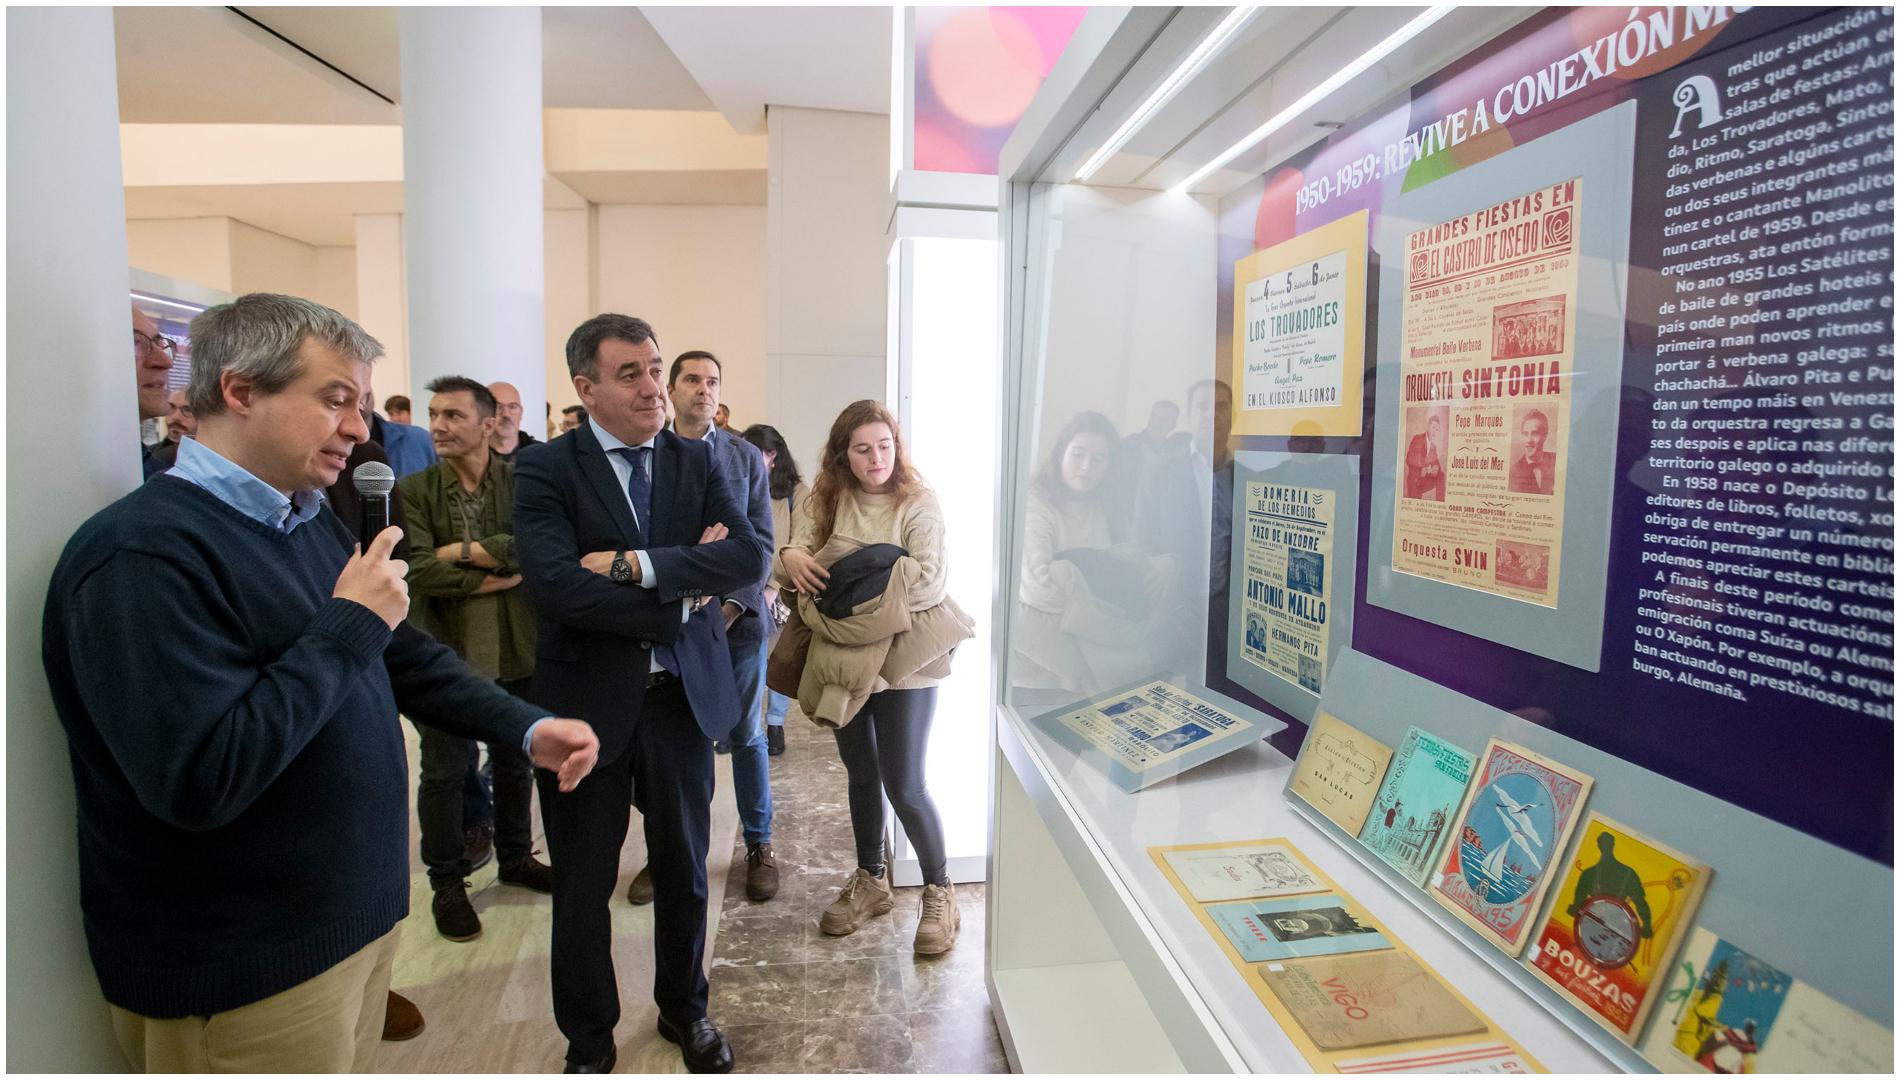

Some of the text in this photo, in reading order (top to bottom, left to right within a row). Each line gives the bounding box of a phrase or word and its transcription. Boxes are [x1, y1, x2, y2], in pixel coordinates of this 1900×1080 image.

[1668, 10, 1876, 139] A mellor situación
[1727, 36, 1869, 97] tras que actúan
[1725, 65, 1858, 119] salas festas:
[1295, 152, 1382, 216] 1950-1959:
[1382, 109, 1469, 177] REVIVE
[1471, 98, 1493, 135] A
[1494, 9, 1675, 125] CONEXIÓN
[1692, 81, 1883, 150] Los Trovadores, Mato,
[1667, 121, 1832, 178] dio, Ritmo, Saratoga,
[1692, 139, 1839, 190] verbenas algúns
[1713, 158, 1858, 205] seus integrantes
[1411, 181, 1574, 250] GRANDES FIESTAS EN
[1664, 221, 1698, 237] tínez
[1726, 197, 1801, 222] cantante
[1691, 201, 1871, 250] cartel 1959. Desde
[1431, 220, 1538, 278] EL CASTRO DE OSEDO
[1661, 233, 1834, 277] orquestras, ata entón
[1697, 244, 1889, 289] ano 1955 Los Satélites
[1264, 280, 1269, 300] 4
[1286, 272, 1292, 293] 5
[1312, 263, 1318, 286] 6
[1680, 271, 1882, 312] baile grandes hoteis
[1249, 320, 1265, 342] LOS
[1658, 298, 1873, 337] país onde poden aprender
[1657, 321, 1883, 356] primeira man novos ritmos
[1406, 361, 1560, 401] ORQUESTA SINTONIA
[1654, 370, 1841, 391] chachachá... Álvaro Pita
[1656, 347, 1866, 375] portar verbena galega:
[1248, 387, 1336, 406] EN EL KIOSCO ALFONSO
[1653, 394, 1796, 411] dan tempo máis
[1456, 414, 1470, 428] Pepe
[1692, 417, 1843, 433] orquestra regresa
[1466, 456, 1478, 469] Luis
[1480, 457, 1489, 470] del
[1490, 456, 1504, 471] Mar
[1675, 437, 1834, 453] despois aplica nas
[1649, 457, 1882, 477] territorio galego adquirido
[1663, 476, 1866, 499] En 1958 nace Depósito
[1258, 500, 1315, 519] DE LOS REMEDIOS
[1647, 495, 1863, 525] editores libros, folletos,
[1252, 525, 1269, 540] PAZO
[1272, 529, 1280, 543] DE
[1284, 532, 1319, 551] ANZOBRE
[1643, 532, 1811, 563] servación permanente
[1645, 513, 1893, 550] obriga entregar número
[1402, 538, 1448, 561] Orquesta
[1455, 548, 1487, 570] SWIN
[1642, 551, 1702, 569] podemos
[1706, 561, 1772, 579] apreciar
[1774, 569, 1822, 587] estes
[1248, 579, 1283, 609] ANTONIO
[1289, 592, 1325, 624] MALLO
[1670, 572, 1833, 612] finais deste período
[1637, 606, 1805, 651] emigración coma Suíza
[1639, 588, 1892, 647] profesionais tiveran actuacións
[1272, 628, 1318, 656] HERMANOS PITA
[1667, 630, 1827, 681] Xapón. Por exemplo,
[1633, 658, 1747, 701] burgo, Alemaña.
[1634, 641, 1859, 710] ban actuando prestixiosos
[1544, 938, 1637, 1013] BOUZAS
[1321, 976, 1369, 1021] VIGO
